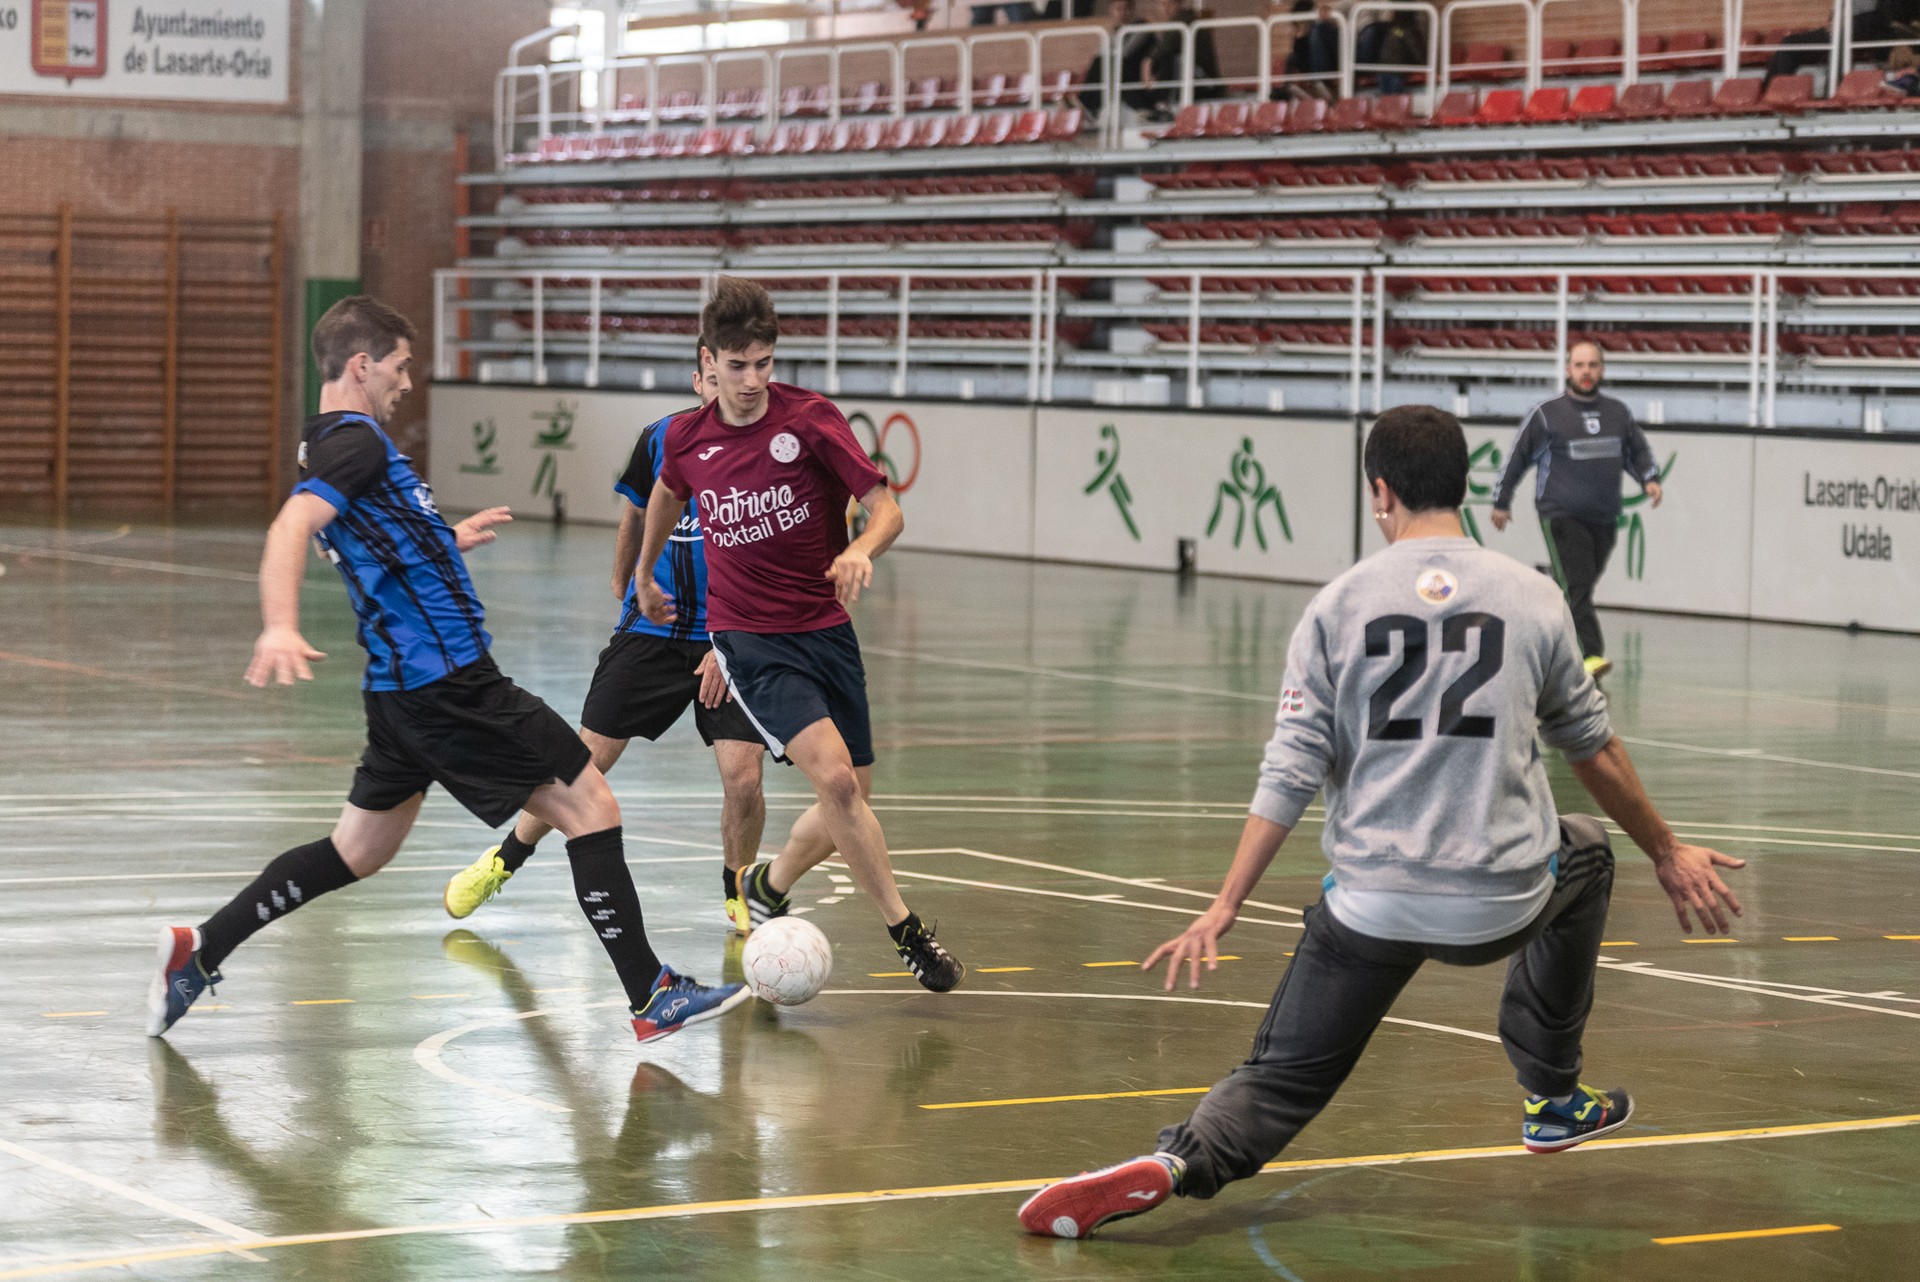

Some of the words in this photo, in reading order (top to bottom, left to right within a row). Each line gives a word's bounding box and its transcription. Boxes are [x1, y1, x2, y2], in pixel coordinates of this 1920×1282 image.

[132, 7, 265, 41] Ayuntamiento
[124, 46, 147, 74] de
[153, 46, 272, 79] Lasarte-Oria
[701, 484, 795, 526] Patricio
[776, 502, 811, 532] Bar
[1843, 522, 1892, 561] Udala
[1365, 612, 1505, 740] 22
